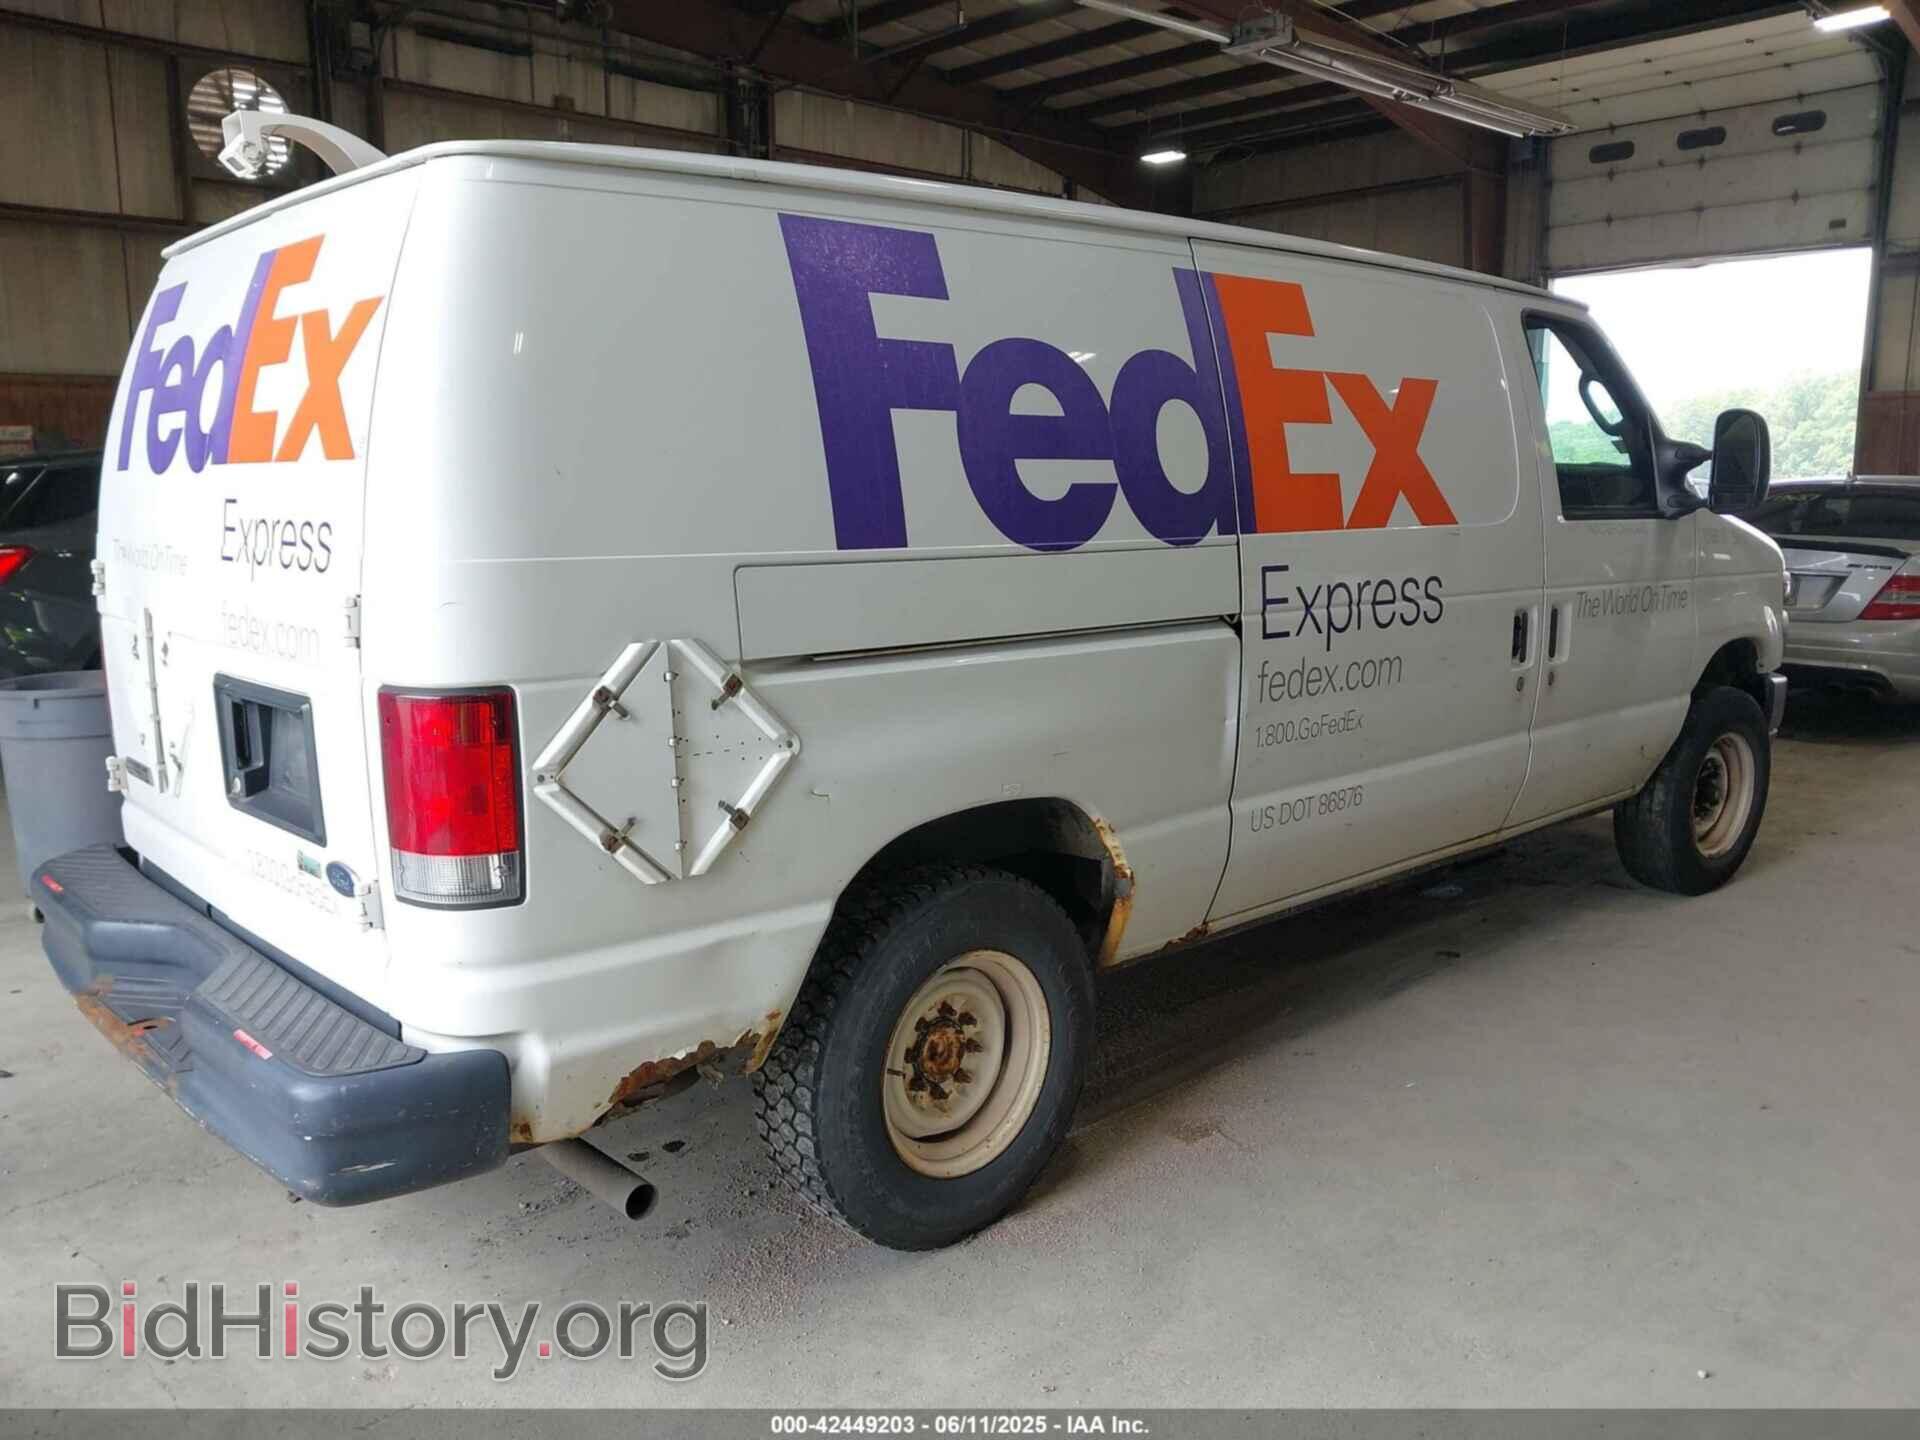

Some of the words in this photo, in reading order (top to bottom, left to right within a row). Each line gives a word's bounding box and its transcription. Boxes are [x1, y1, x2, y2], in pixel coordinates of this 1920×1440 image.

[117, 233, 386, 475] FedEx
[778, 212, 1460, 552] FedEx
[220, 498, 333, 582] Express
[218, 599, 321, 662] fedex.com
[1260, 564, 1444, 652] Express
[1576, 590, 1600, 618] The
[1601, 587, 1639, 617] World
[1641, 584, 1660, 613] On
[1660, 583, 1689, 612] Time
[1257, 655, 1403, 704] fedex.com
[1256, 708, 1366, 748] 1.800.GoFedEx
[1250, 805, 1276, 833] US
[1279, 795, 1316, 826] DOT
[1318, 784, 1363, 816] 86876
